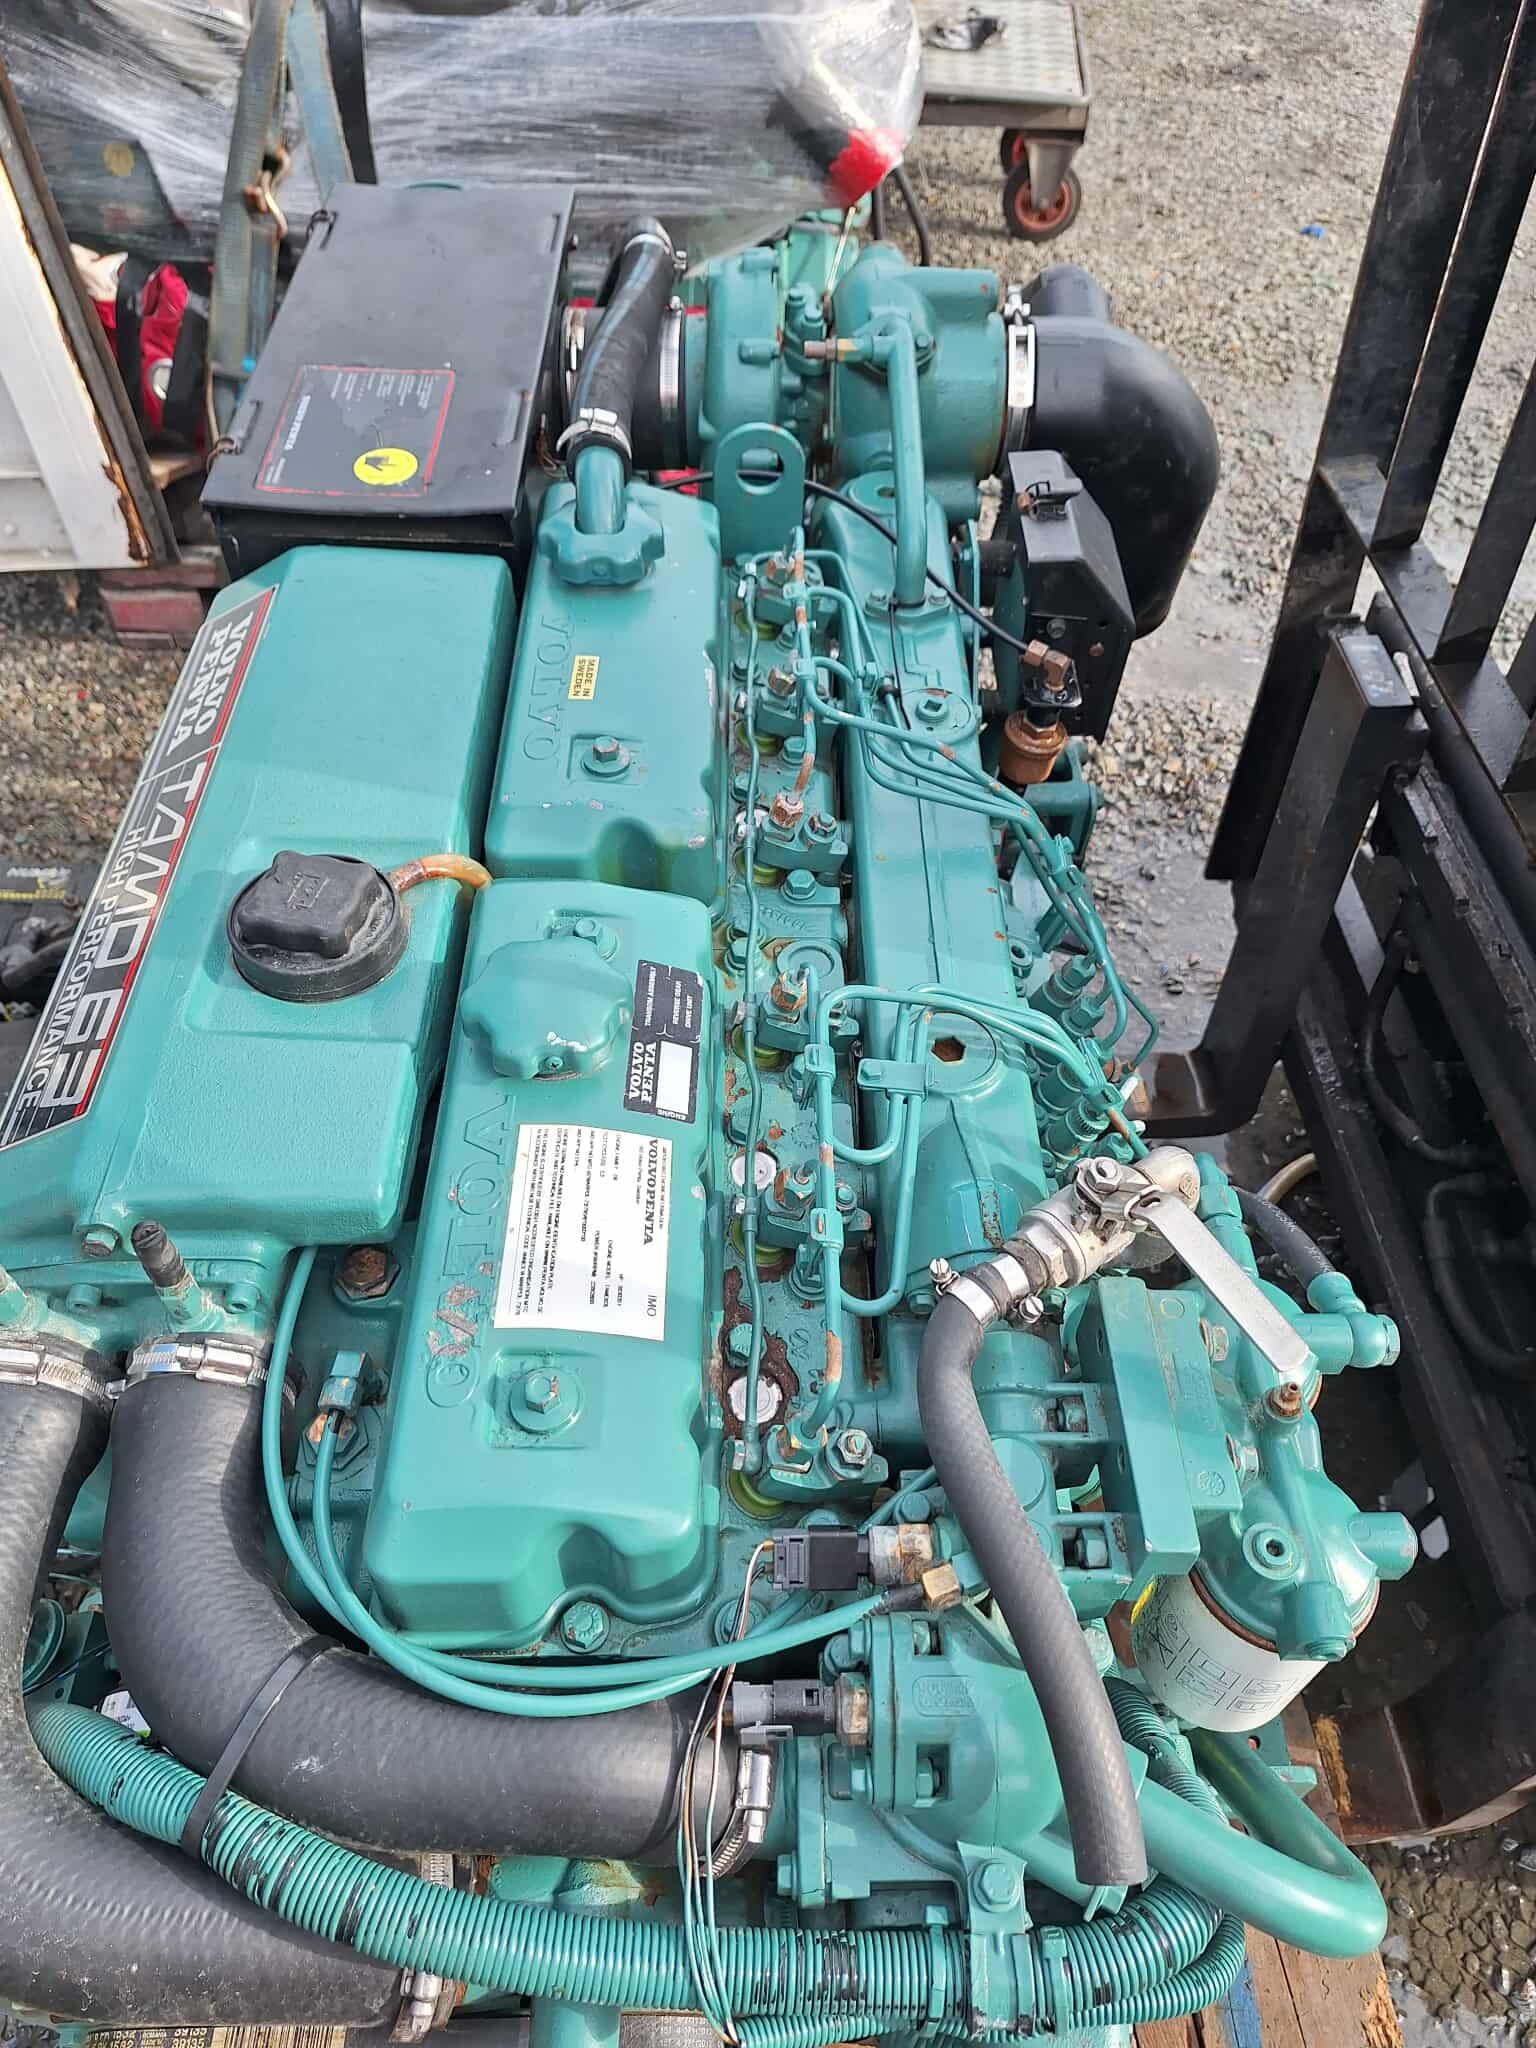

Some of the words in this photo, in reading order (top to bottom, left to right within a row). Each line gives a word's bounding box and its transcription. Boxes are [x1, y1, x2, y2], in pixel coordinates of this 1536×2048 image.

[166, 622, 232, 756] PENTA
[194, 611, 254, 736] VOLVO
[523, 615, 573, 763] VOLVO
[572, 659, 585, 697] SWEDEN
[582, 687, 591, 697] IN
[583, 659, 595, 686] MADE
[95, 762, 207, 968] TAMD
[107, 826, 145, 889] HIGH
[17, 895, 118, 1112] PERFORMANCE
[39, 988, 124, 1108] 63
[629, 1041, 644, 1100] VOLVO
[641, 1042, 656, 1104] PENTA
[426, 1094, 516, 1408] VOLVO
[647, 1295, 657, 1317] IMO
